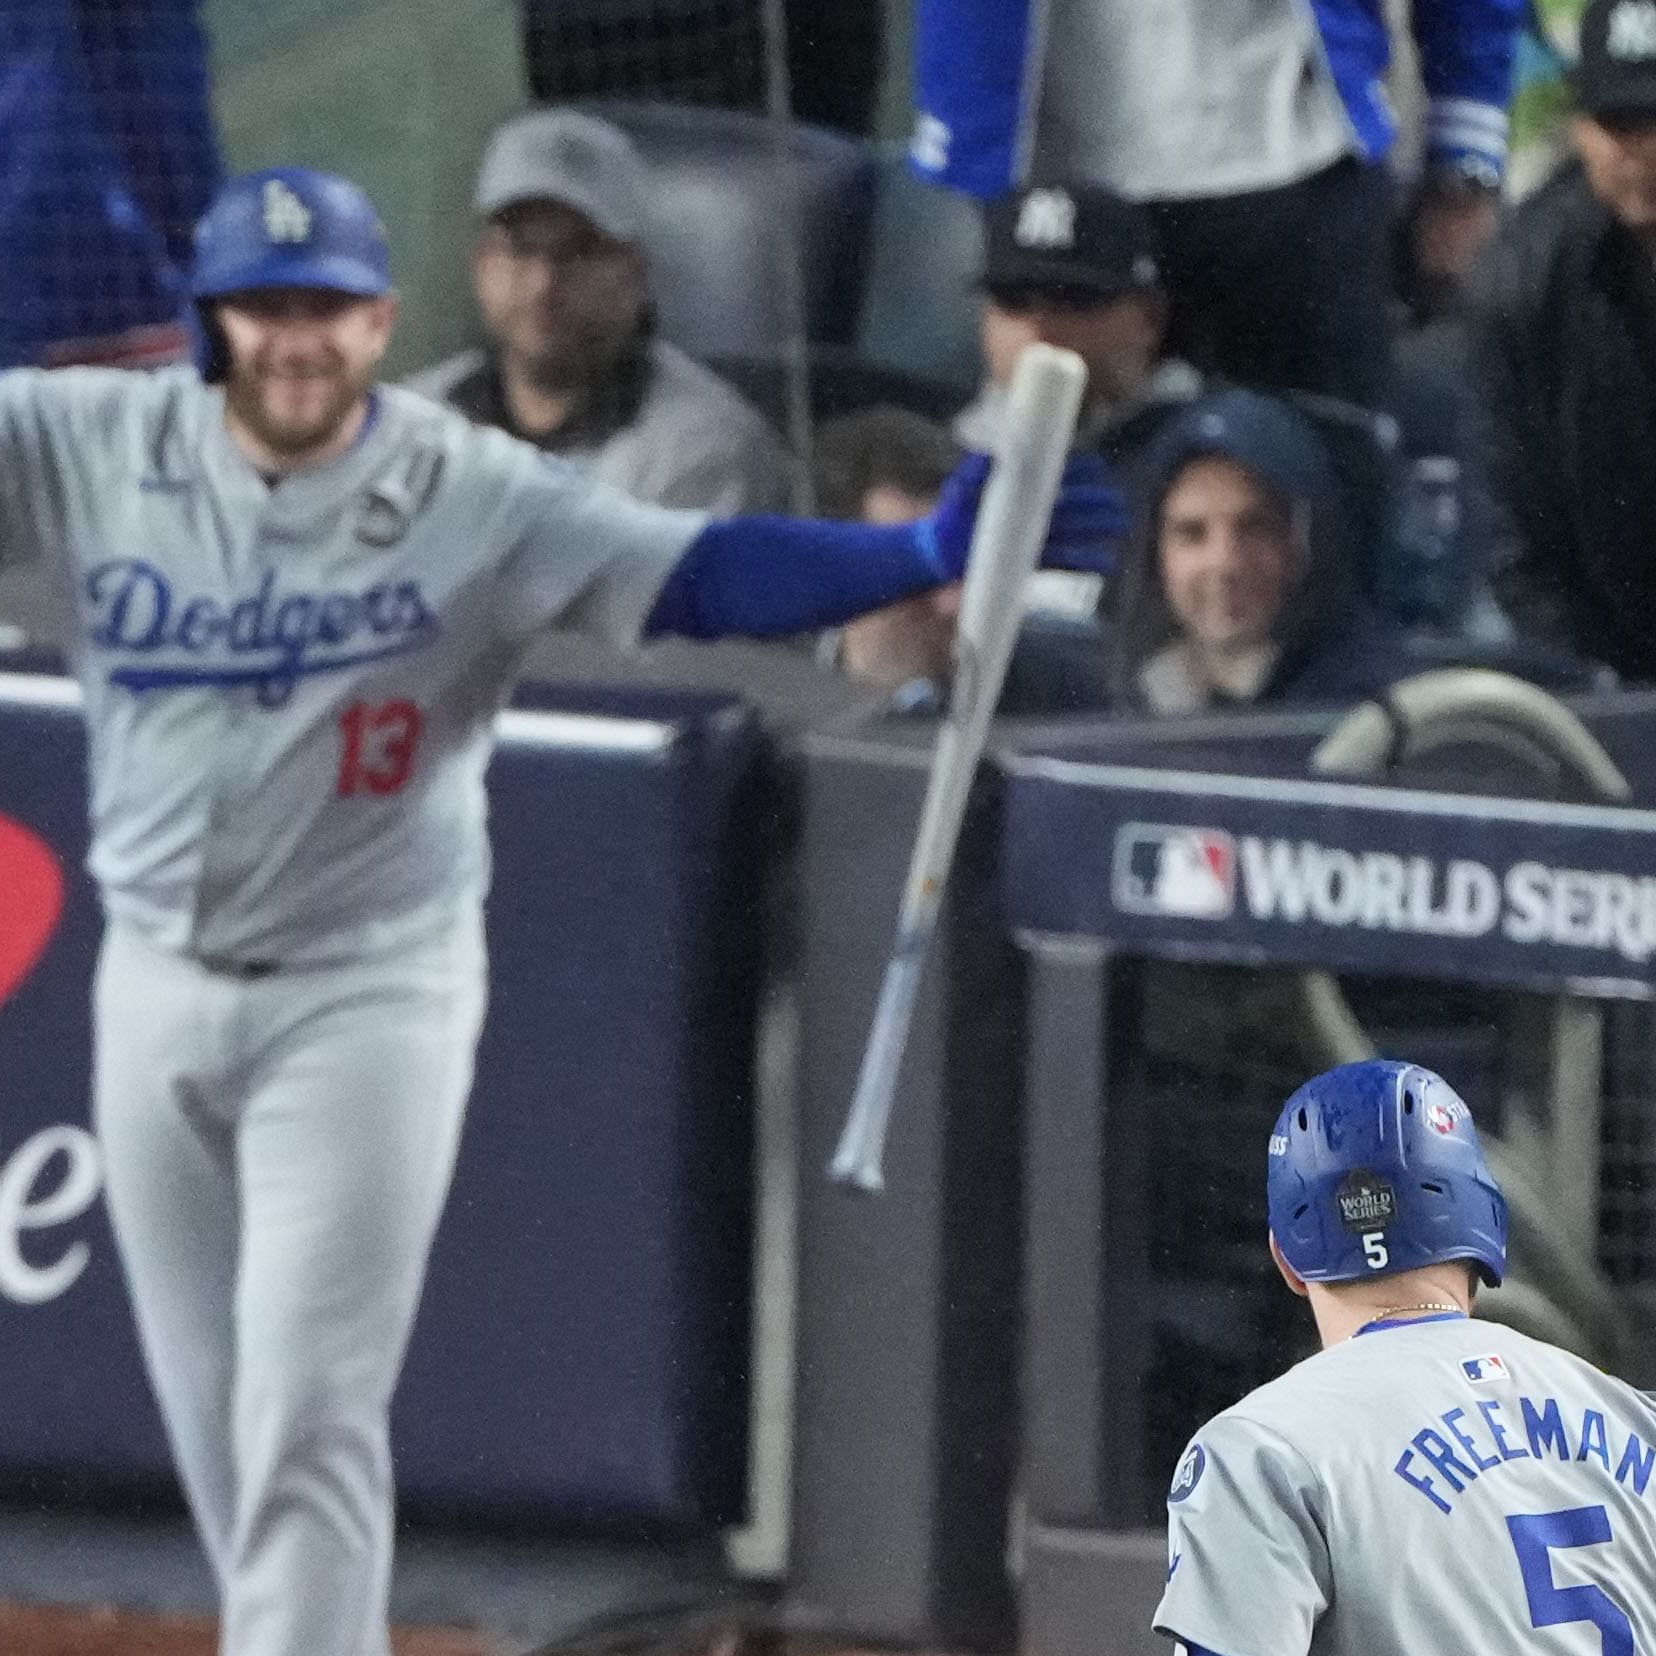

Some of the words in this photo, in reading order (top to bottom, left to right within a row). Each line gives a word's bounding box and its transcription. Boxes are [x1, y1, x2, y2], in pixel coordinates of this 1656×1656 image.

[263, 178, 312, 243] LA
[87, 560, 440, 711] Dodgers
[338, 699, 421, 799] 13
[1242, 835, 1502, 938] WORLD
[1340, 1192, 1392, 1211] WORLD
[1344, 1204, 1392, 1221] SERIES
[1362, 1232, 1389, 1270] 5
[1394, 1397, 1656, 1515] FREEMAN
